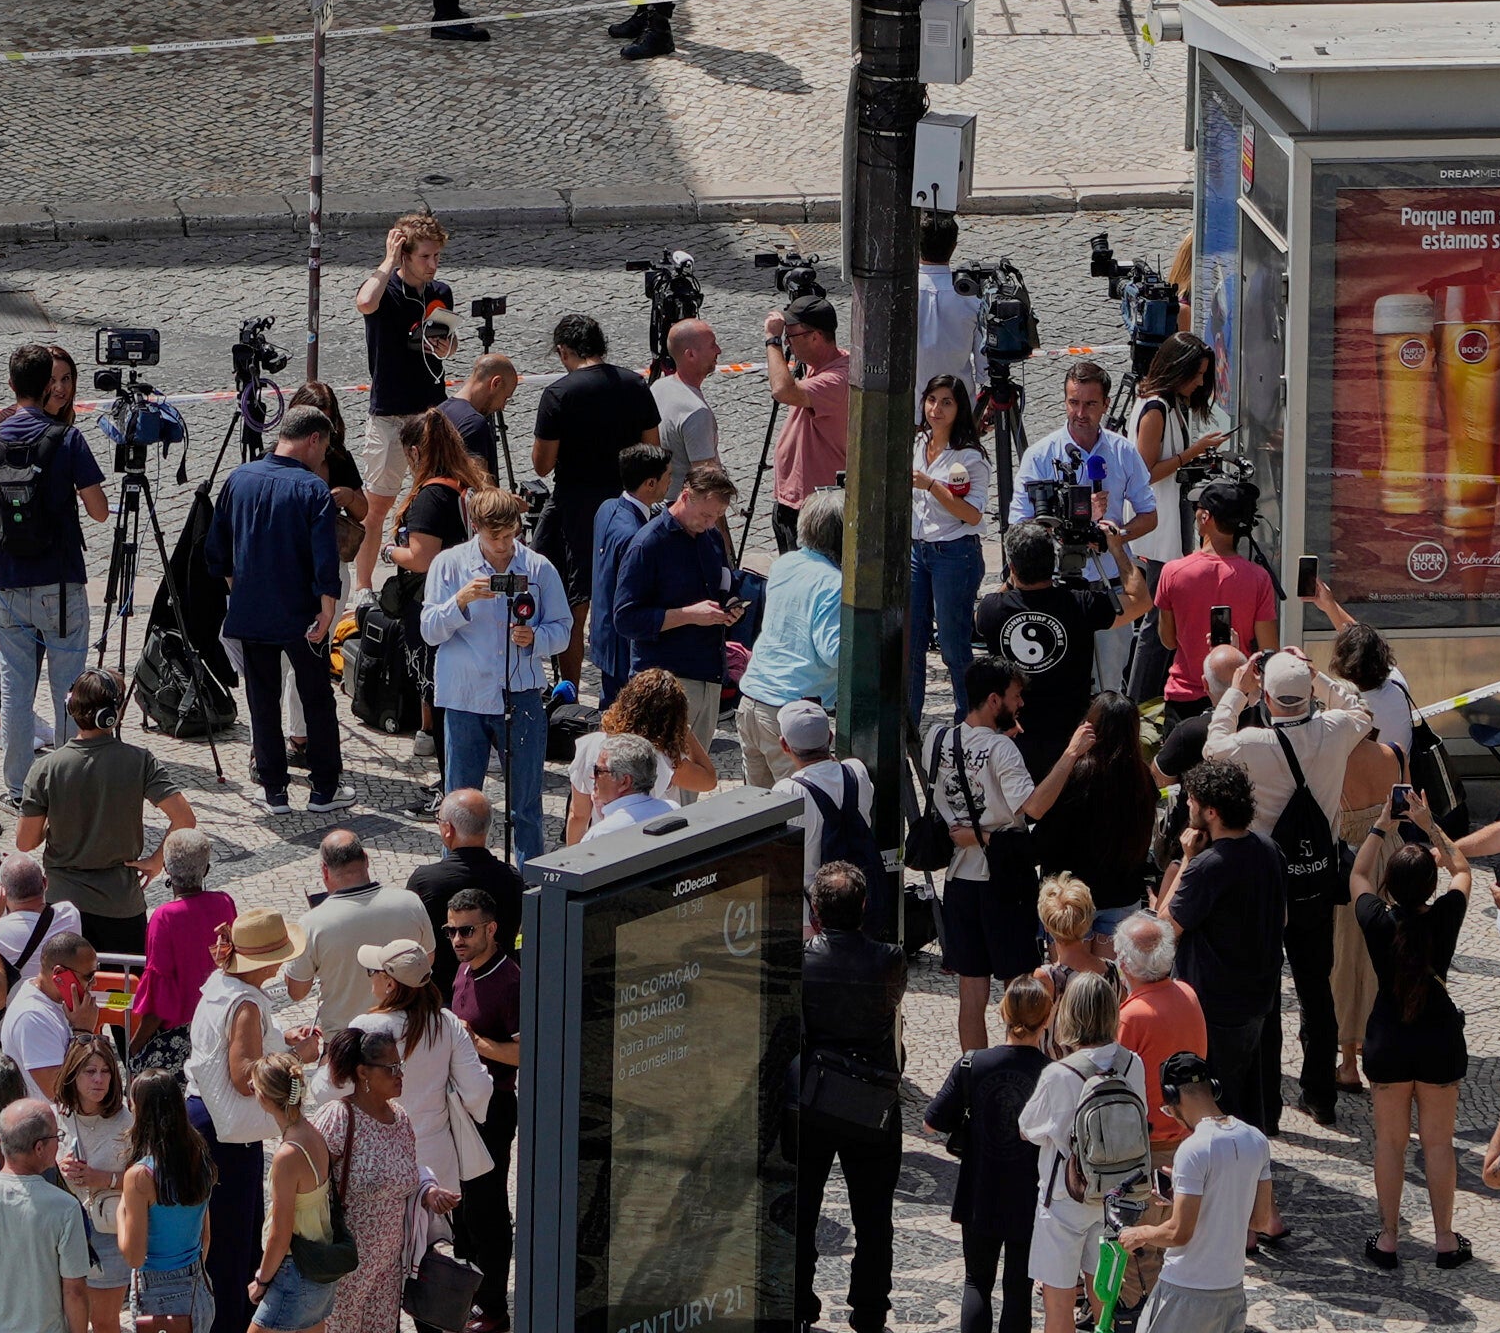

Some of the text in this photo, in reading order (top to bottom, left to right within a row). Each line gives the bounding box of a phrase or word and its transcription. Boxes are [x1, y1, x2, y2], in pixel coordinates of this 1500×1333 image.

[1401, 207, 1457, 230] Porque
[1460, 209, 1495, 225] nem
[1421, 232, 1488, 250] estamos
[1461, 346, 1484, 354] BOCK
[1411, 553, 1443, 562] SUPER
[1413, 561, 1441, 571] BOCK
[1453, 551, 1486, 565] Sabor
[519, 606, 527, 615] 4
[543, 872, 561, 882] 787
[672, 872, 718, 897] JCDecaux
[734, 905, 756, 939] 21
[619, 962, 701, 1006] NO CORAÇÃO
[619, 992, 686, 1030] DO BAIRRO
[618, 1020, 686, 1062] para melhor
[724, 1284, 744, 1316] 21
